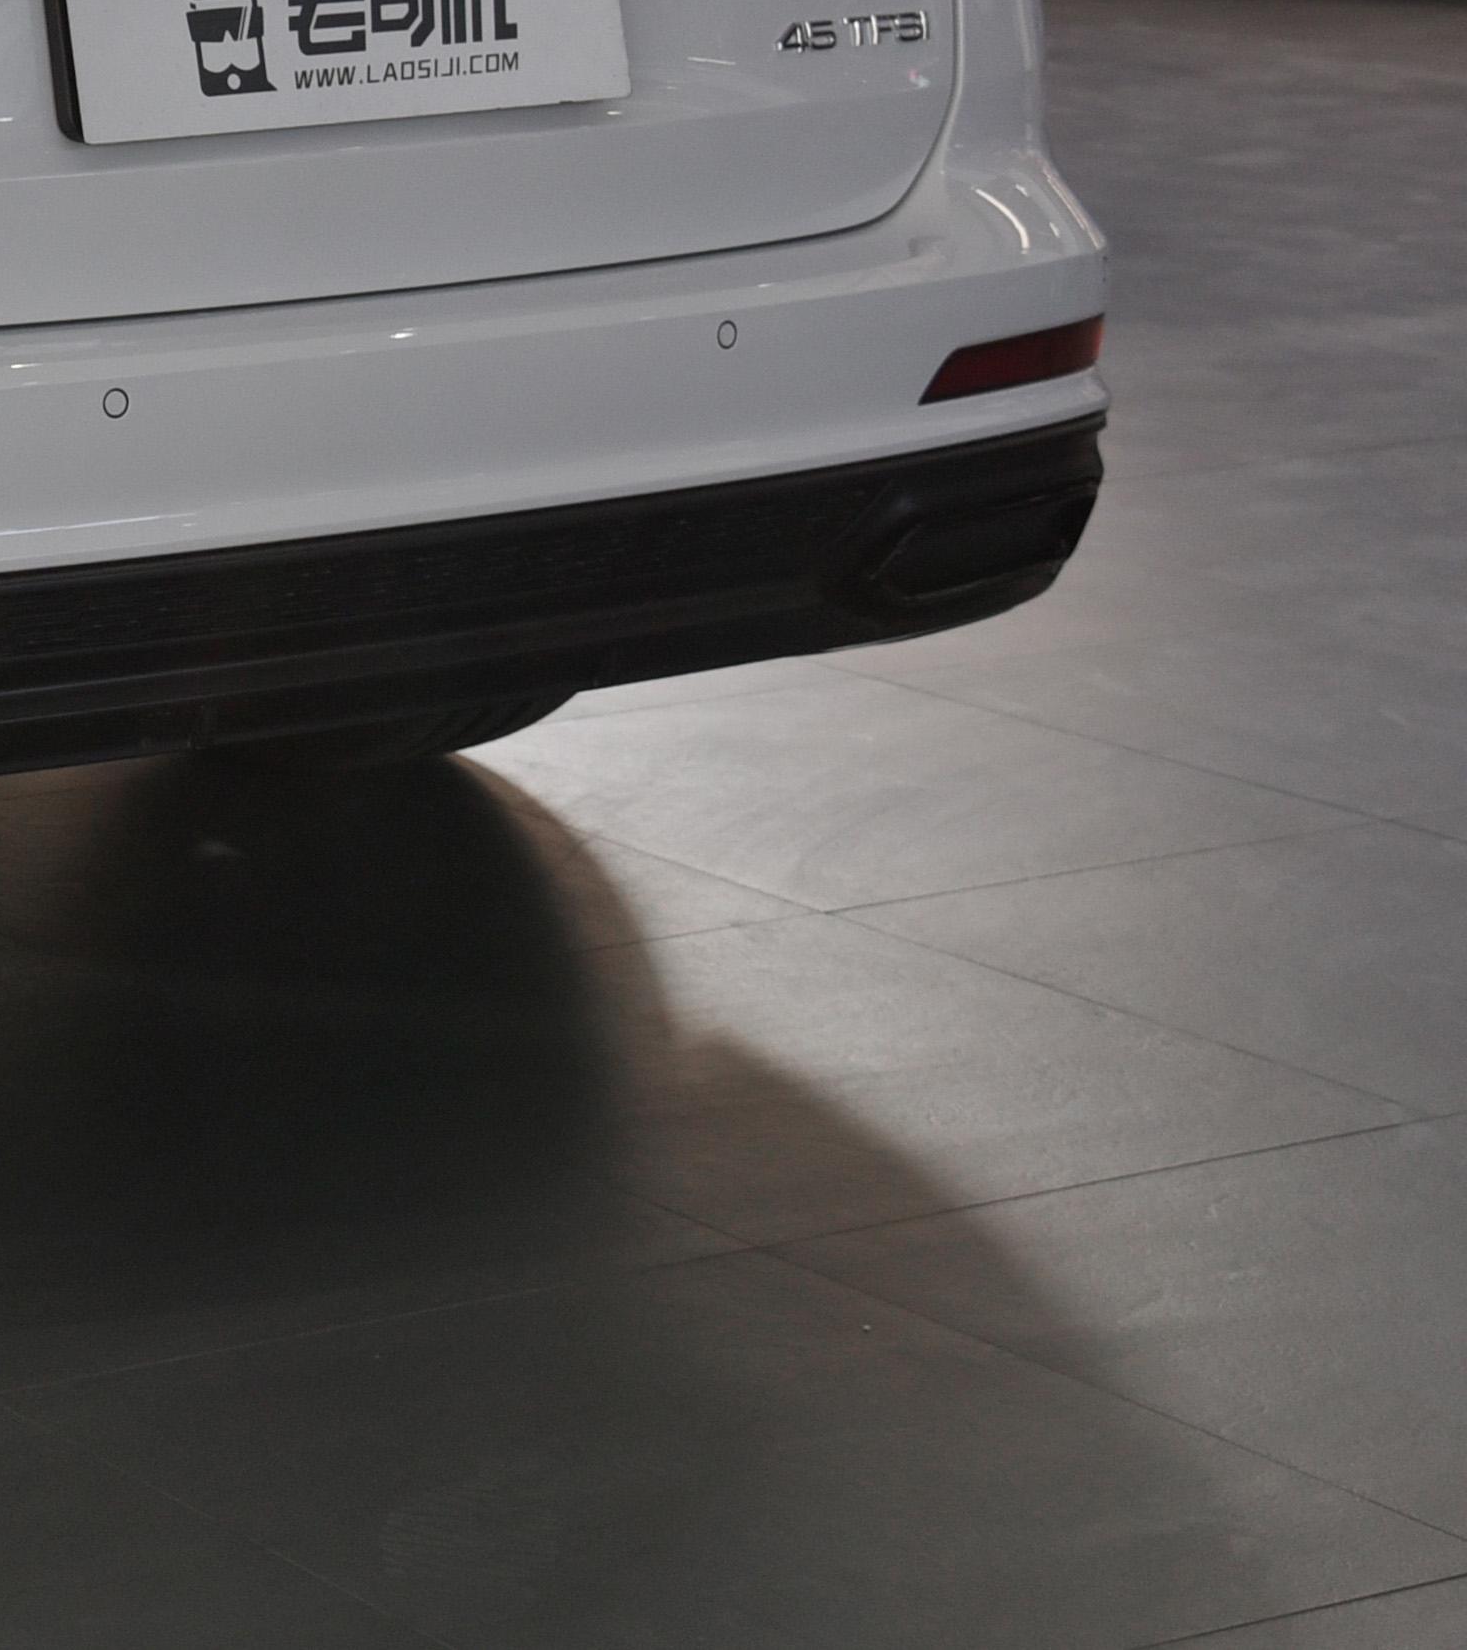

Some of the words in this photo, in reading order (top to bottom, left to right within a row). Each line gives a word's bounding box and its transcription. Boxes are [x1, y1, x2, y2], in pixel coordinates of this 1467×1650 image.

[775, 19, 837, 53] 45
[843, 10, 928, 47] TFSI
[294, 51, 519, 90] WWW.LAOSIJI.COM
